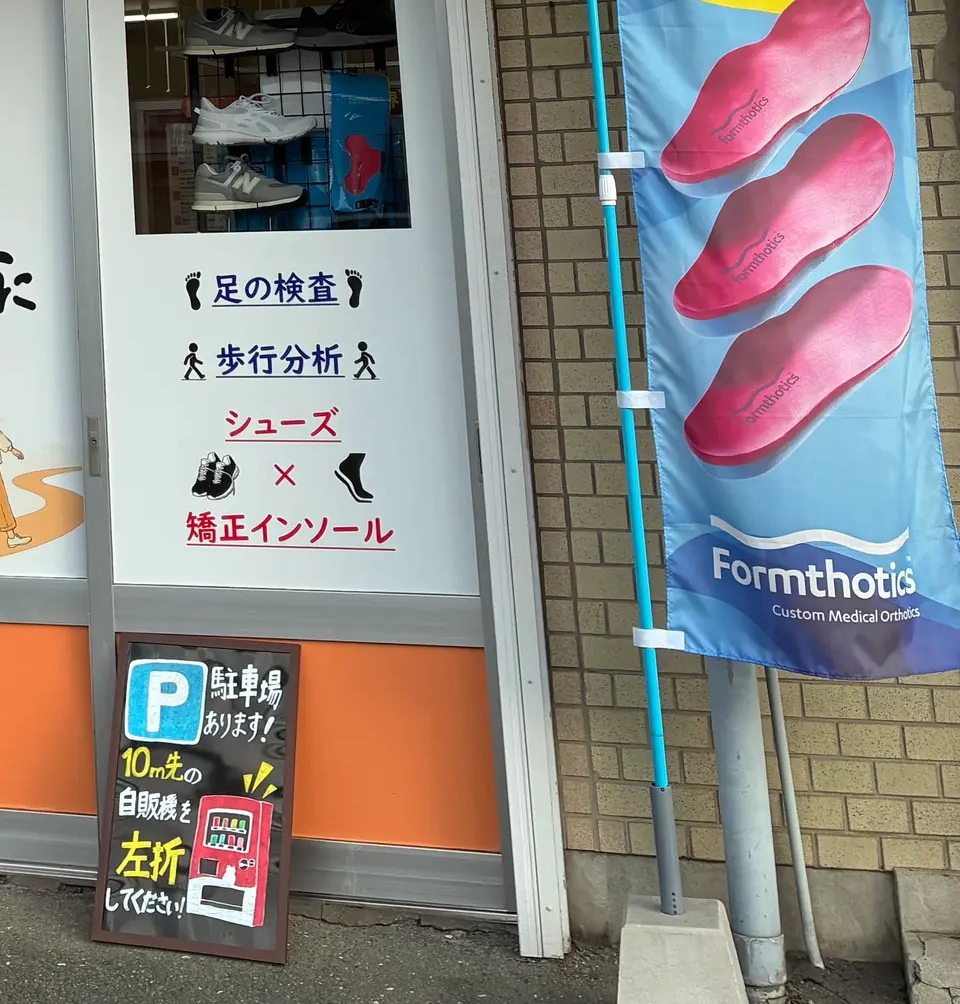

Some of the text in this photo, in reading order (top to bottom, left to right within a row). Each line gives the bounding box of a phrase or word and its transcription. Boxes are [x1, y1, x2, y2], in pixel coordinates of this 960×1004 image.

[213, 271, 338, 303] 足の検査
[216, 343, 343, 375] 歩行分析
[225, 406, 339, 437] シューズ
[186, 511, 394, 544] 矯正インソール
[712, 546, 916, 599] Formthotics
[772, 604, 920, 624] Custom Medical Orthotics
[146, 671, 189, 733] P
[210, 663, 283, 710] 駐車場
[121, 747, 202, 785] 10m先の
[118, 786, 192, 824] 自販機を
[116, 830, 186, 886] 左折
